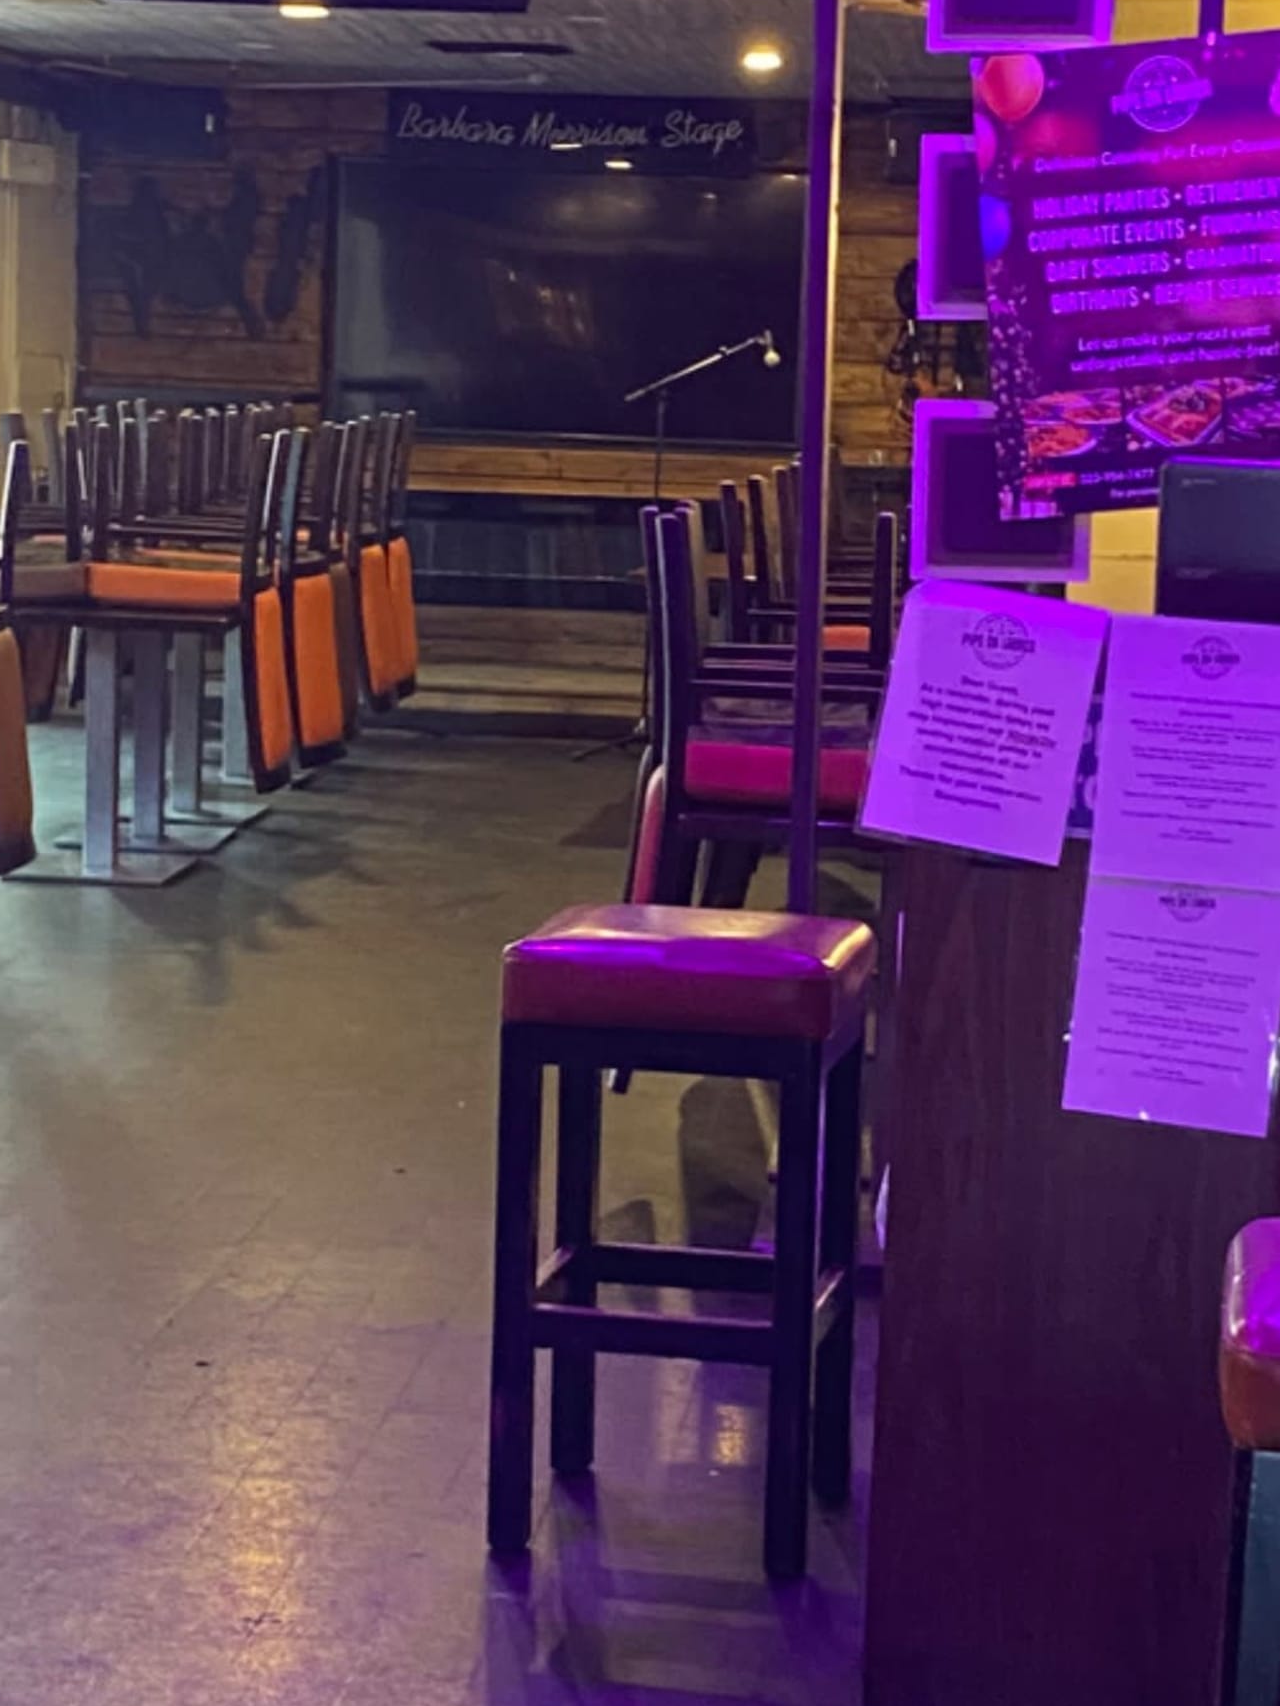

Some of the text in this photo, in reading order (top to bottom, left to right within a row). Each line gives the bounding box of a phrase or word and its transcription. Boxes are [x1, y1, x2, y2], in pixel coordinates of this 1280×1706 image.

[396, 101, 743, 159] Barbara Morrison Stage
[1032, 194, 1099, 220] HOLIDAY
[1103, 186, 1171, 213] PARTIES
[1027, 224, 1121, 253] CORPORATE
[1124, 218, 1187, 244] EVENTS
[1078, 336, 1100, 353] Let
[1122, 333, 1158, 349] make
[1162, 331, 1195, 347] your
